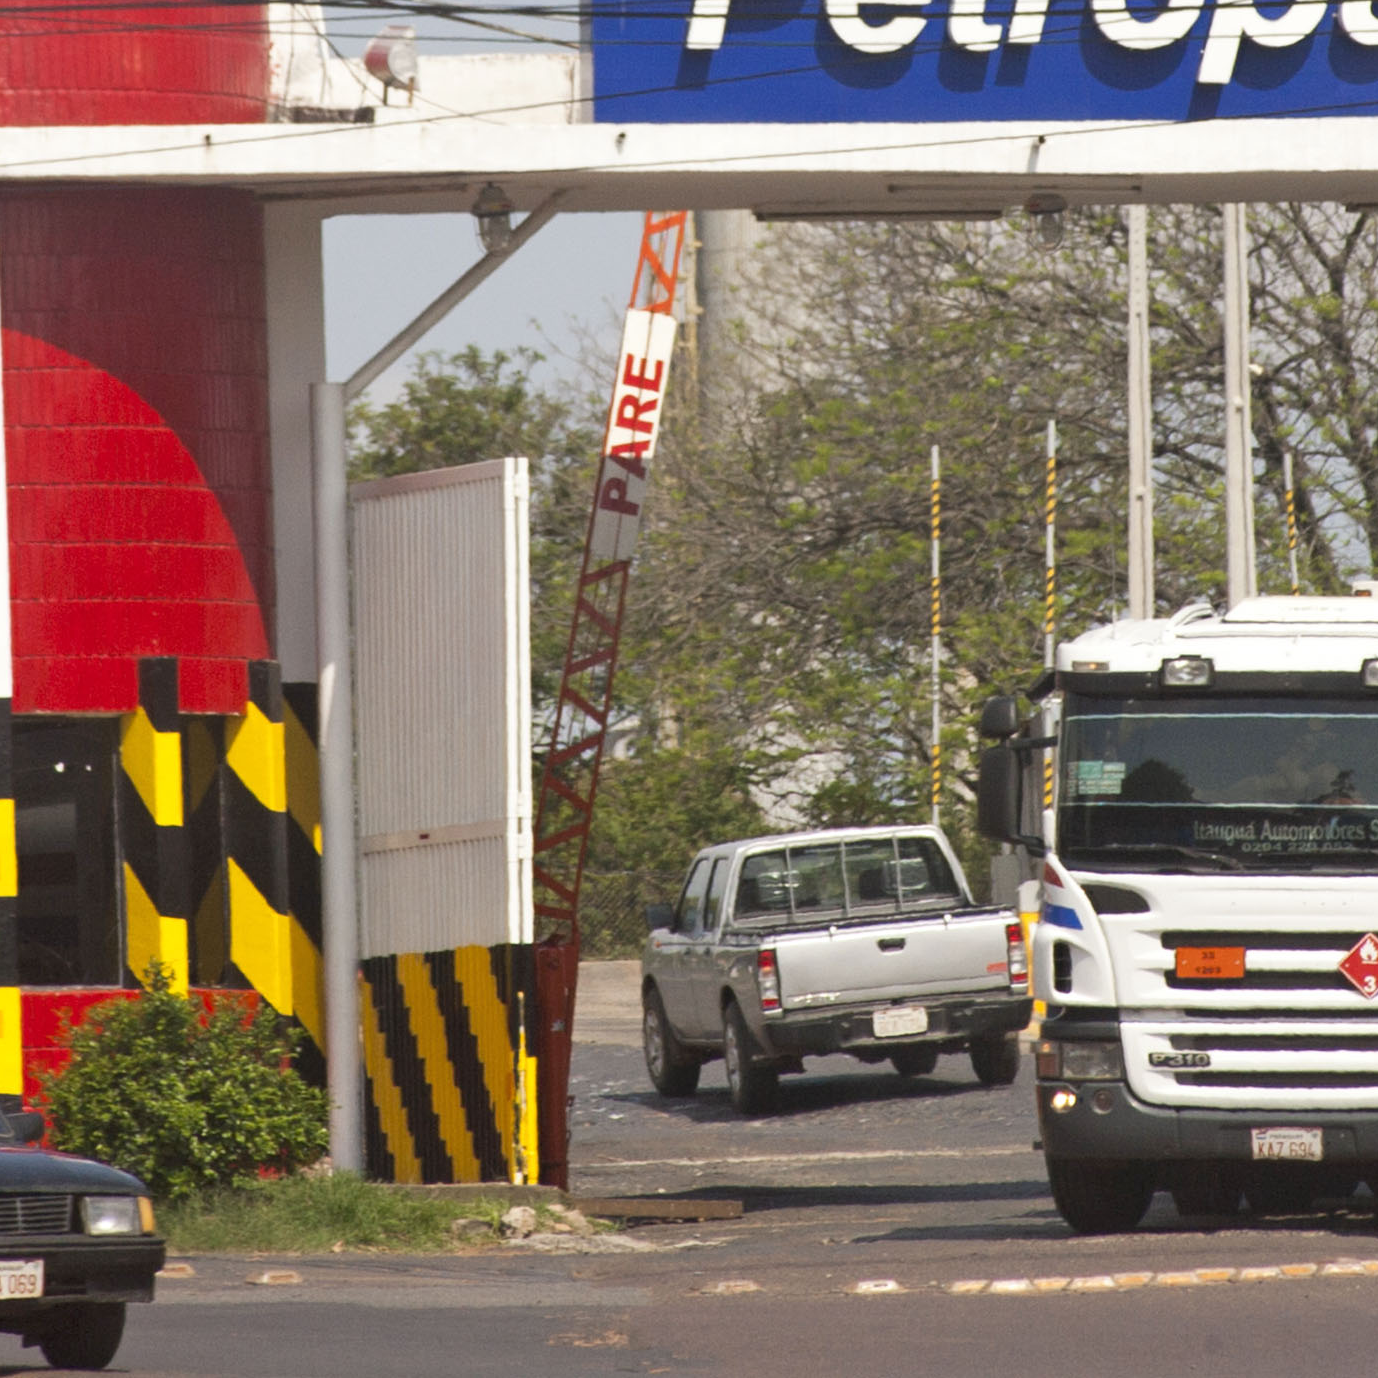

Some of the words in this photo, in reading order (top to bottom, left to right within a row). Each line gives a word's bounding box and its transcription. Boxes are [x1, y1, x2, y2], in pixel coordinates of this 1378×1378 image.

[599, 353, 664, 516] PARE
[1363, 975, 1377, 993] 3
[1151, 1052, 1165, 1065] P
[1170, 1053, 1210, 1067] 310
[1257, 1141, 1284, 1159] KAZ
[1289, 1141, 1316, 1159] 694
[8, 1273, 37, 1294] 069
